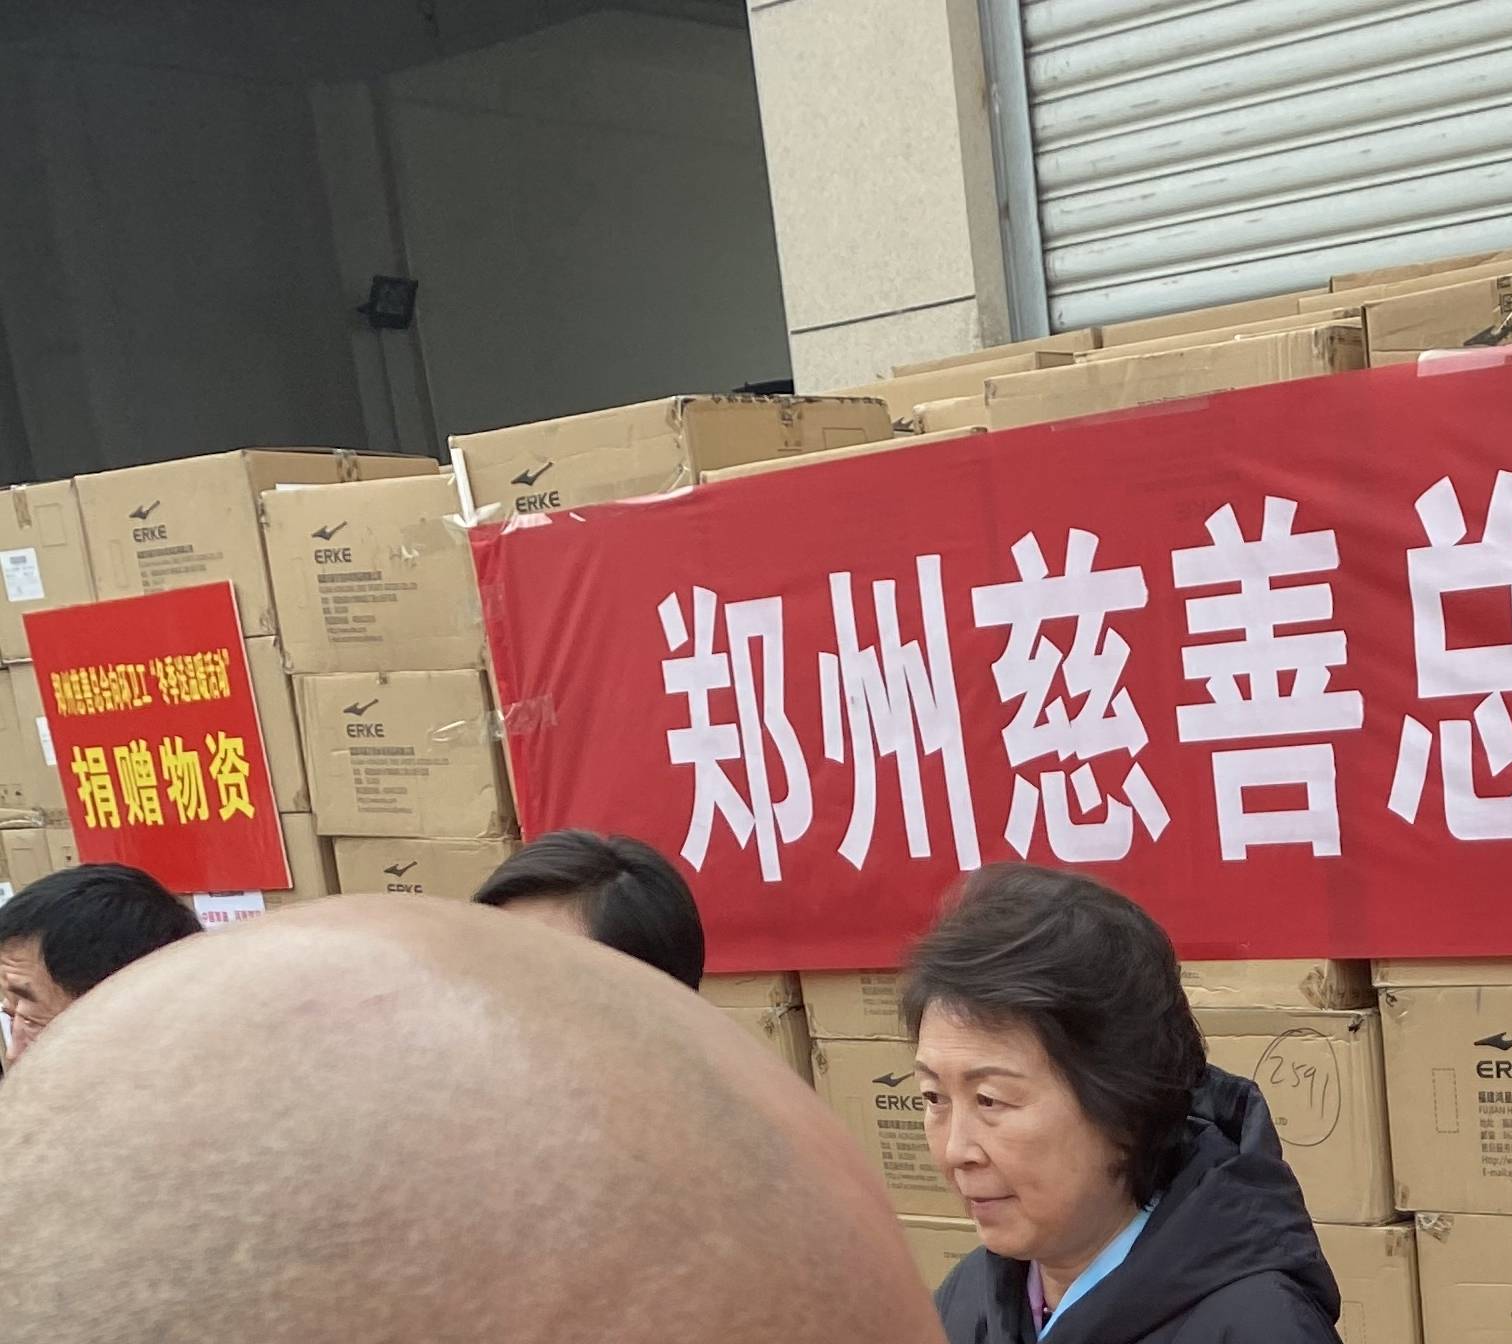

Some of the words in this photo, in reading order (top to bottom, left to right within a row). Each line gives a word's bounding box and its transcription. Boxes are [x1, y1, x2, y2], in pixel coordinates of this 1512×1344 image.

[515, 491, 561, 513] ERKE
[132, 524, 168, 543] ERKE
[314, 547, 352, 564] ERKE
[346, 723, 385, 738] ERKE
[71, 731, 255, 829] 捐赠物资
[875, 1094, 924, 1111] ERKE
